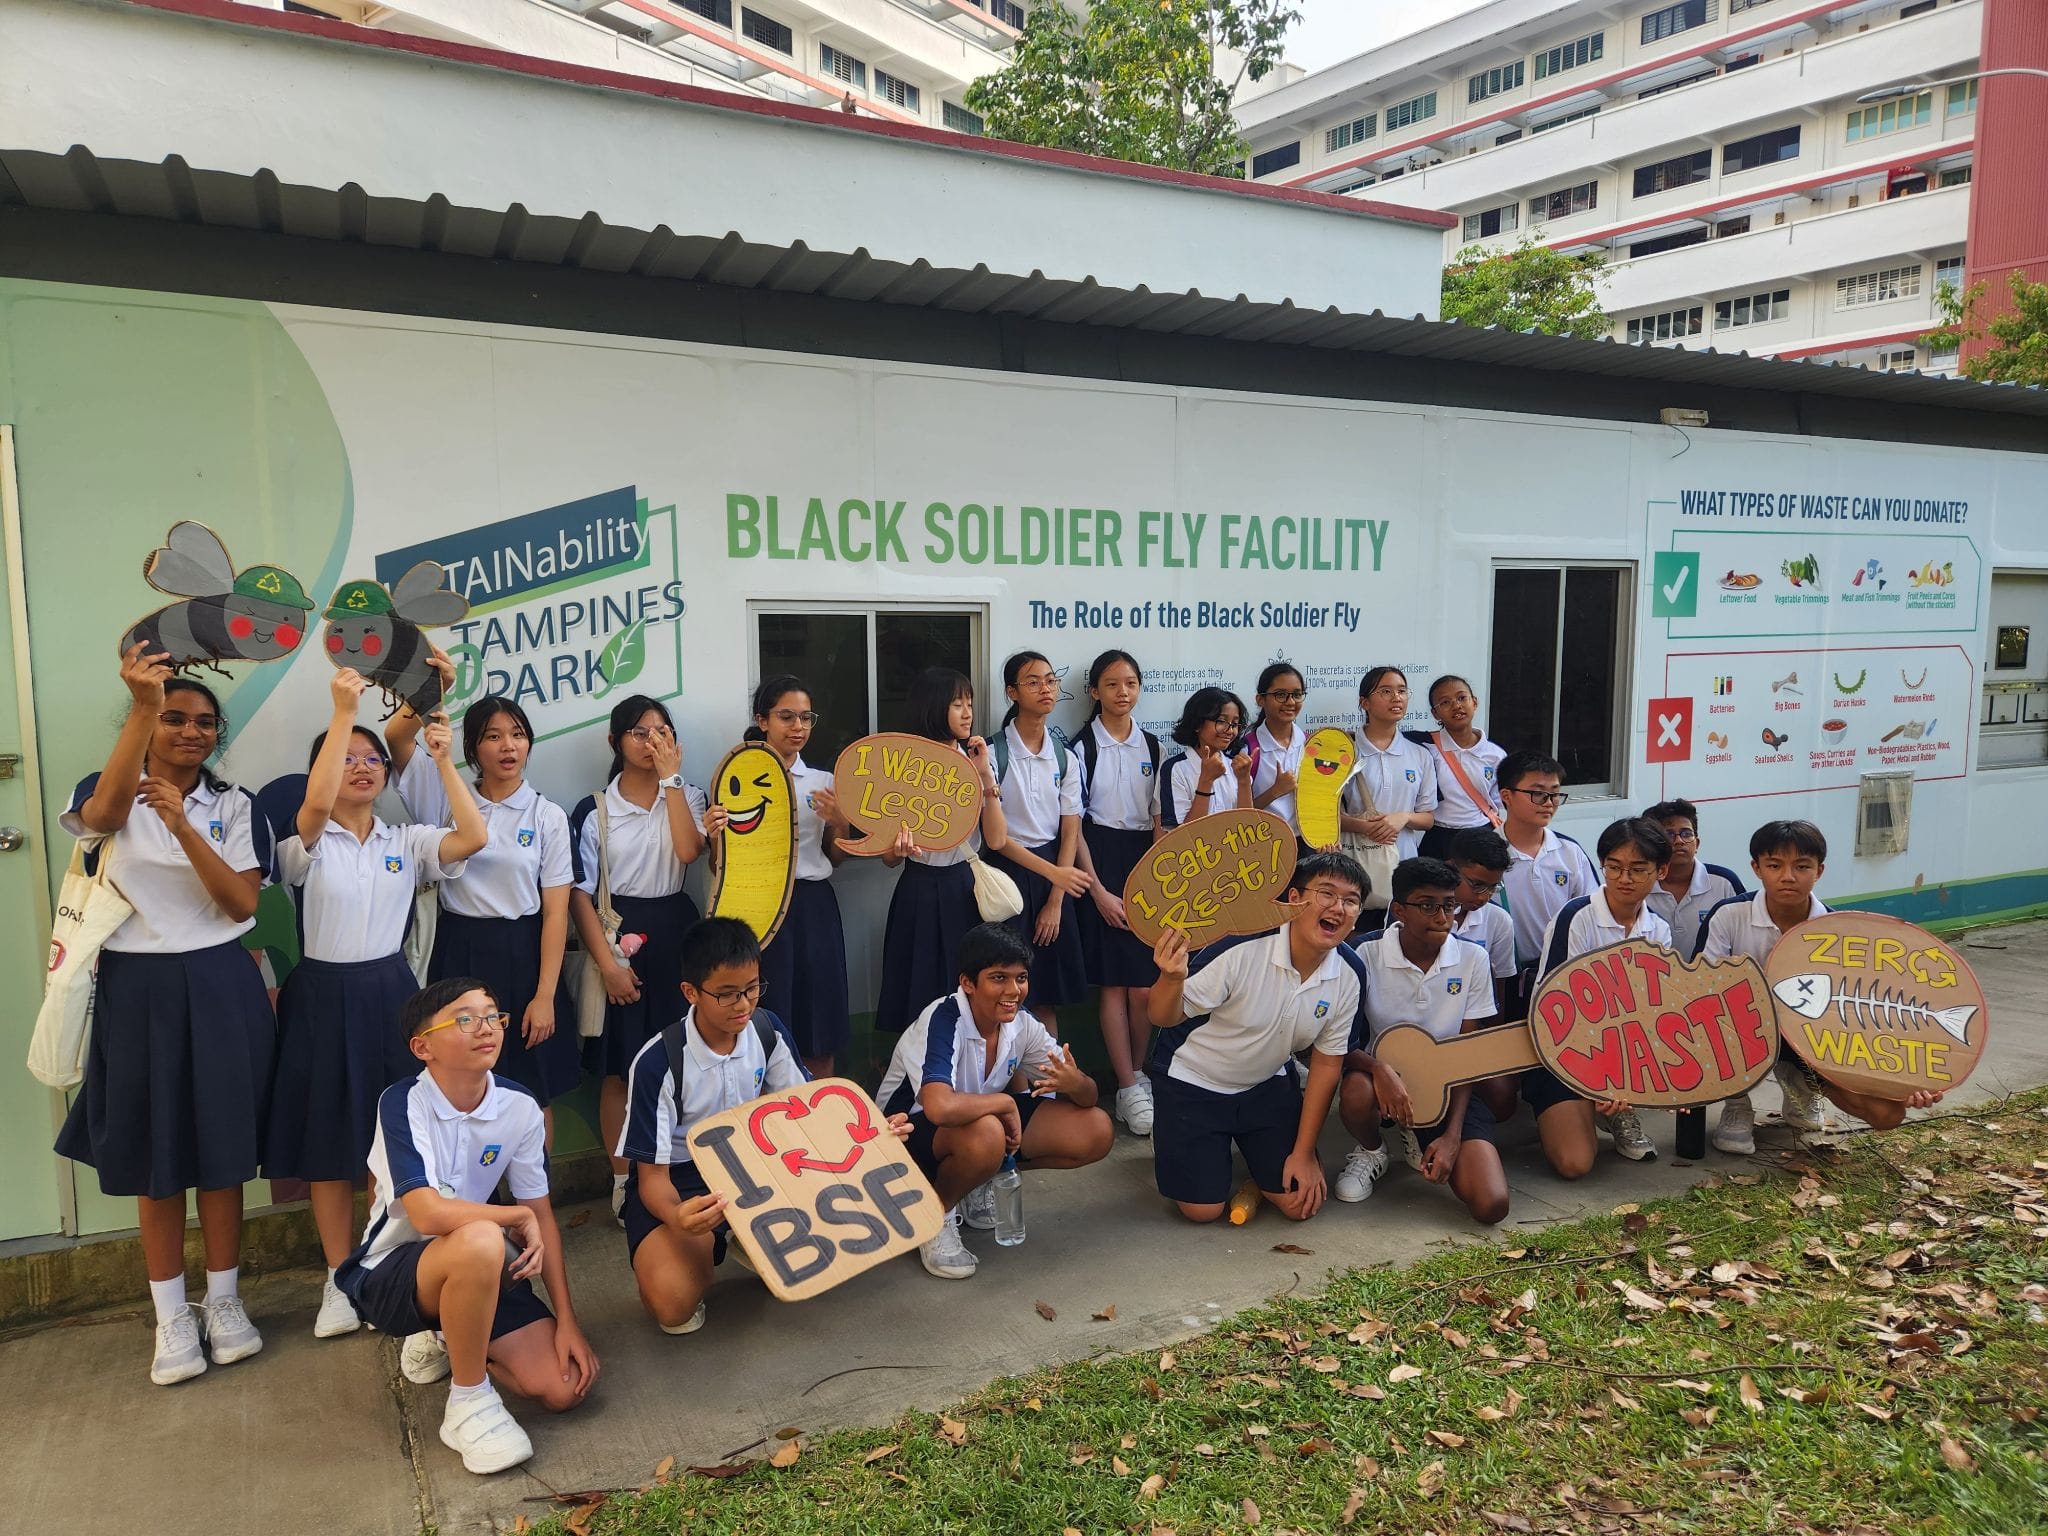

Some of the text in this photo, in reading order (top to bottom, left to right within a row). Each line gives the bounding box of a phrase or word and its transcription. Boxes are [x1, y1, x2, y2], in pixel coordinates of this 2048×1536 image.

[1681, 490, 1968, 523] WHAT TYPES OF WASTE CAN YOU DONATE?
[726, 493, 1389, 571] BLACK SOLDIER FLY FACILITY
[1719, 594, 1757, 603] Leftover Food
[1775, 594, 1829, 605] Vegetable Trimmings
[1842, 593, 1900, 603] Meat and Fish Trimmings
[450, 580, 688, 663] TAMPINES
[1029, 601, 1361, 632] The Role of the Black Soldier Fly
[1162, 668, 1195, 681] recyclers
[1197, 670, 1205, 678] as
[1208, 668, 1223, 680] they
[1305, 666, 1317, 675] The
[1320, 666, 1343, 675] excreta
[1345, 666, 1351, 674] is
[1353, 665, 1368, 674] used
[1143, 684, 1166, 693] waste
[1168, 682, 1182, 692] into
[1328, 676, 1358, 689] organic).
[1709, 704, 1735, 713] Batteries
[1775, 701, 1801, 712] Big Bones
[1305, 713, 1364, 724] Larvae are high in
[1706, 753, 1732, 765] Eggshells
[1754, 755, 1776, 764] Seafood
[1847, 749, 1856, 757] and
[1811, 761, 1820, 769] any
[853, 745, 977, 807] I Waste
[1131, 820, 1273, 920] I Eat the
[1538, 947, 1670, 1046] DON'T
[1556, 978, 1769, 1093] WASTE
[1802, 1022, 1952, 1082] WASTE
[694, 1125, 774, 1209] I
[750, 1162, 923, 1287] BSF
